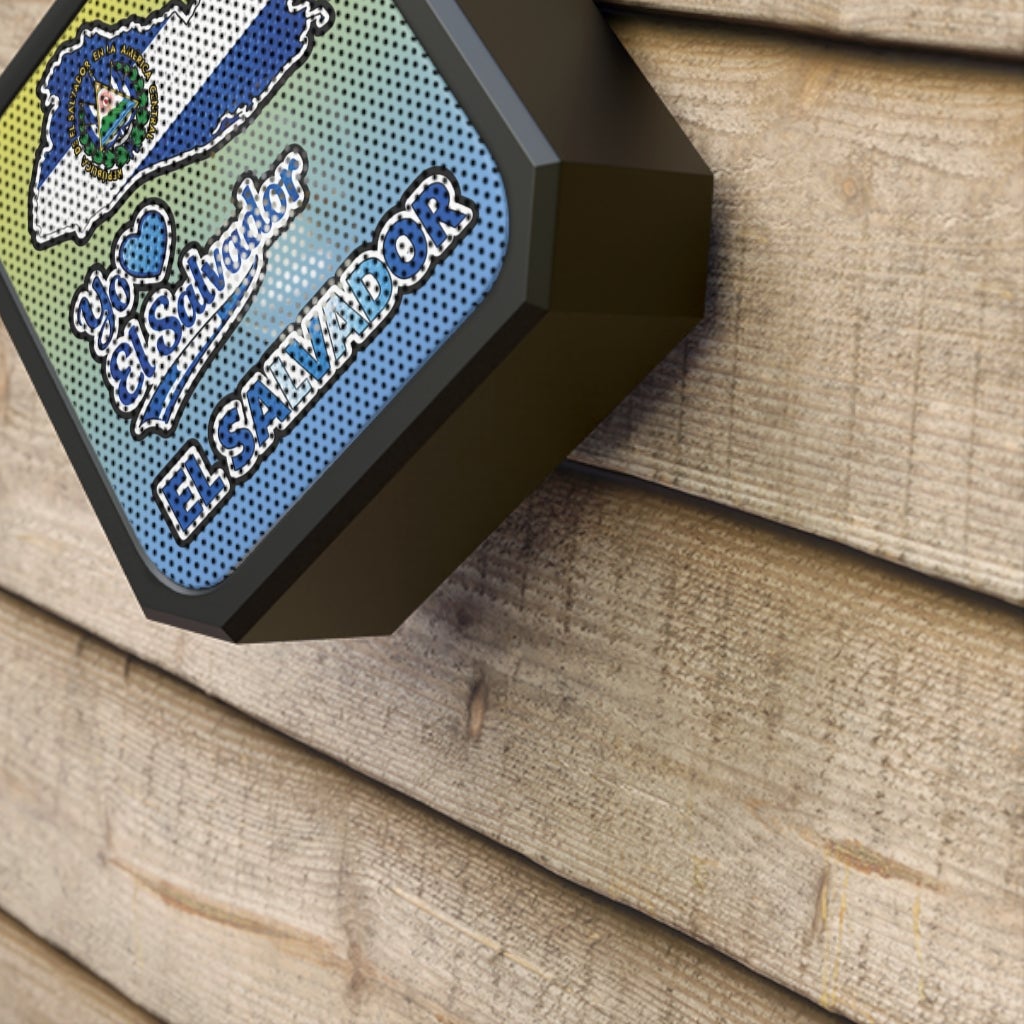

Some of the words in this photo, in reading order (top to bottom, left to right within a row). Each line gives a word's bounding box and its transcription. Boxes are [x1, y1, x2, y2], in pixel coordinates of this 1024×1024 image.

[67, 60, 91, 122] SALVADOR
[92, 47, 105, 62] EN
[75, 272, 133, 353] Yo
[108, 323, 156, 407] El
[147, 155, 301, 357] Salvador
[159, 452, 228, 533] EL
[214, 179, 471, 473] SALVADOR
